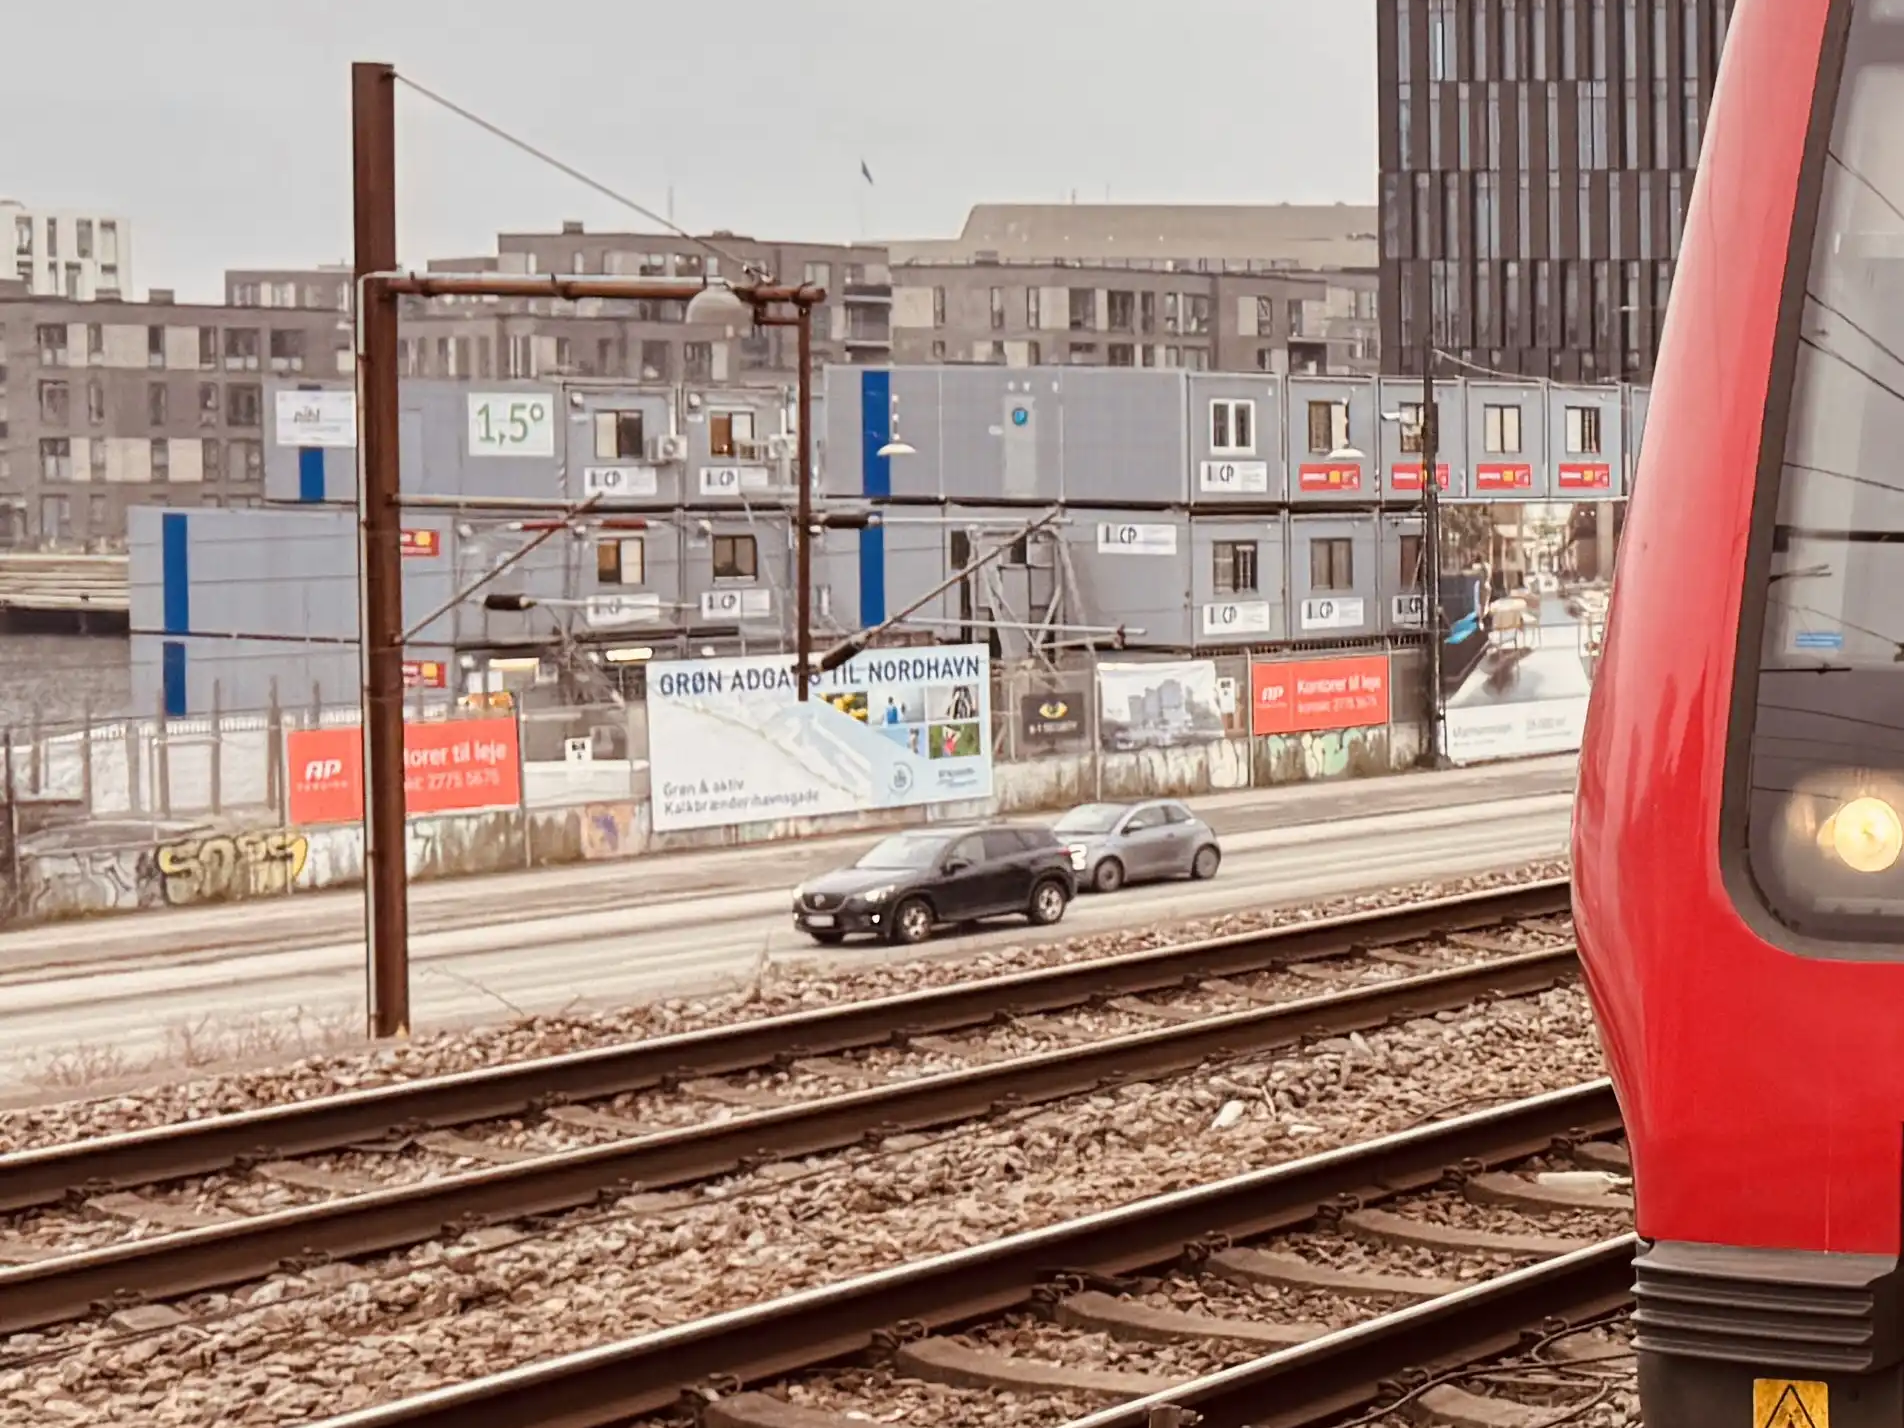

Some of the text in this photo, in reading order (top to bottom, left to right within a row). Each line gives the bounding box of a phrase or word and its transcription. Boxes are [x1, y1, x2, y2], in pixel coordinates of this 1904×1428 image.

[660, 655, 980, 697] GRØN ADGA TIL NORDHAVN
[403, 747, 449, 769] torer
[452, 741, 471, 764] til
